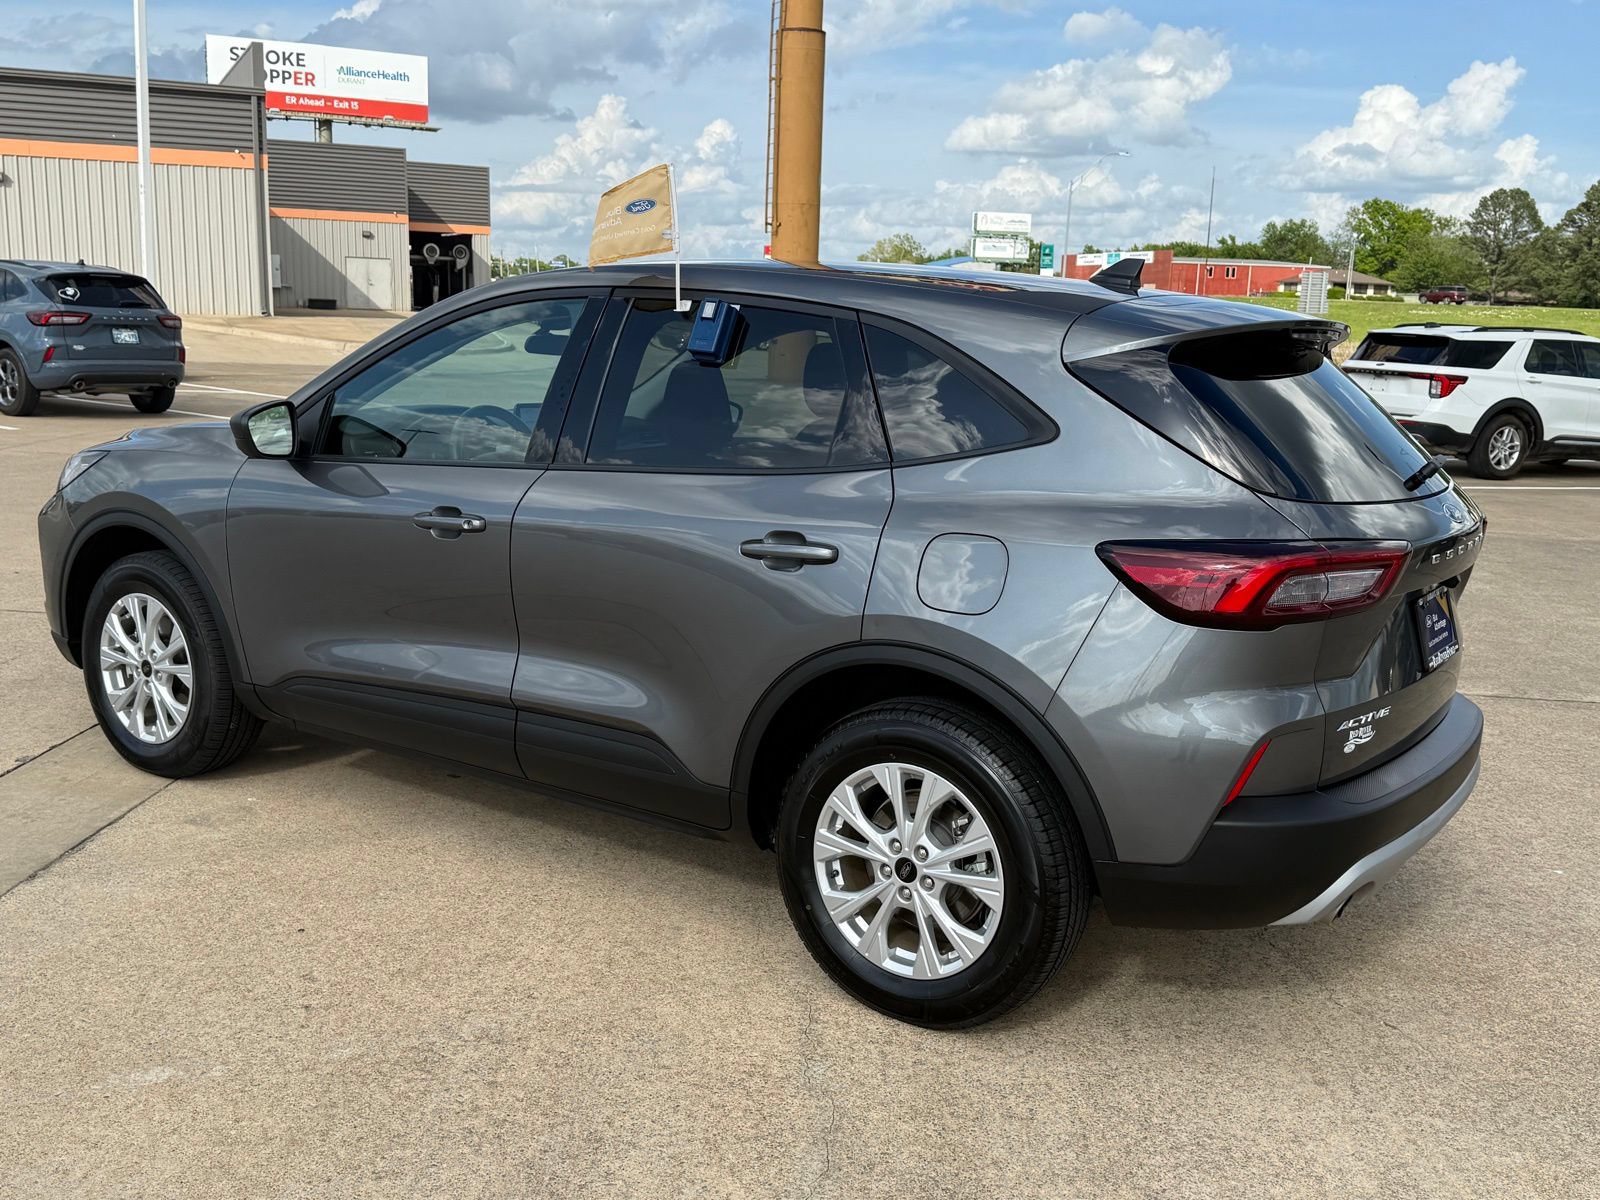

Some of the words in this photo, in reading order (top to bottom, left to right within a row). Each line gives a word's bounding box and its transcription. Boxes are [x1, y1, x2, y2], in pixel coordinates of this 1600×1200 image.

[230, 46, 306, 67] SOKE
[336, 66, 410, 82] AllianceHealth
[338, 77, 366, 86] DURANT
[285, 95, 297, 105] ER
[298, 97, 325, 108] Ahead
[333, 99, 349, 110] Exit
[350, 101, 359, 110] 15
[1337, 706, 1392, 731] ACTIVE
